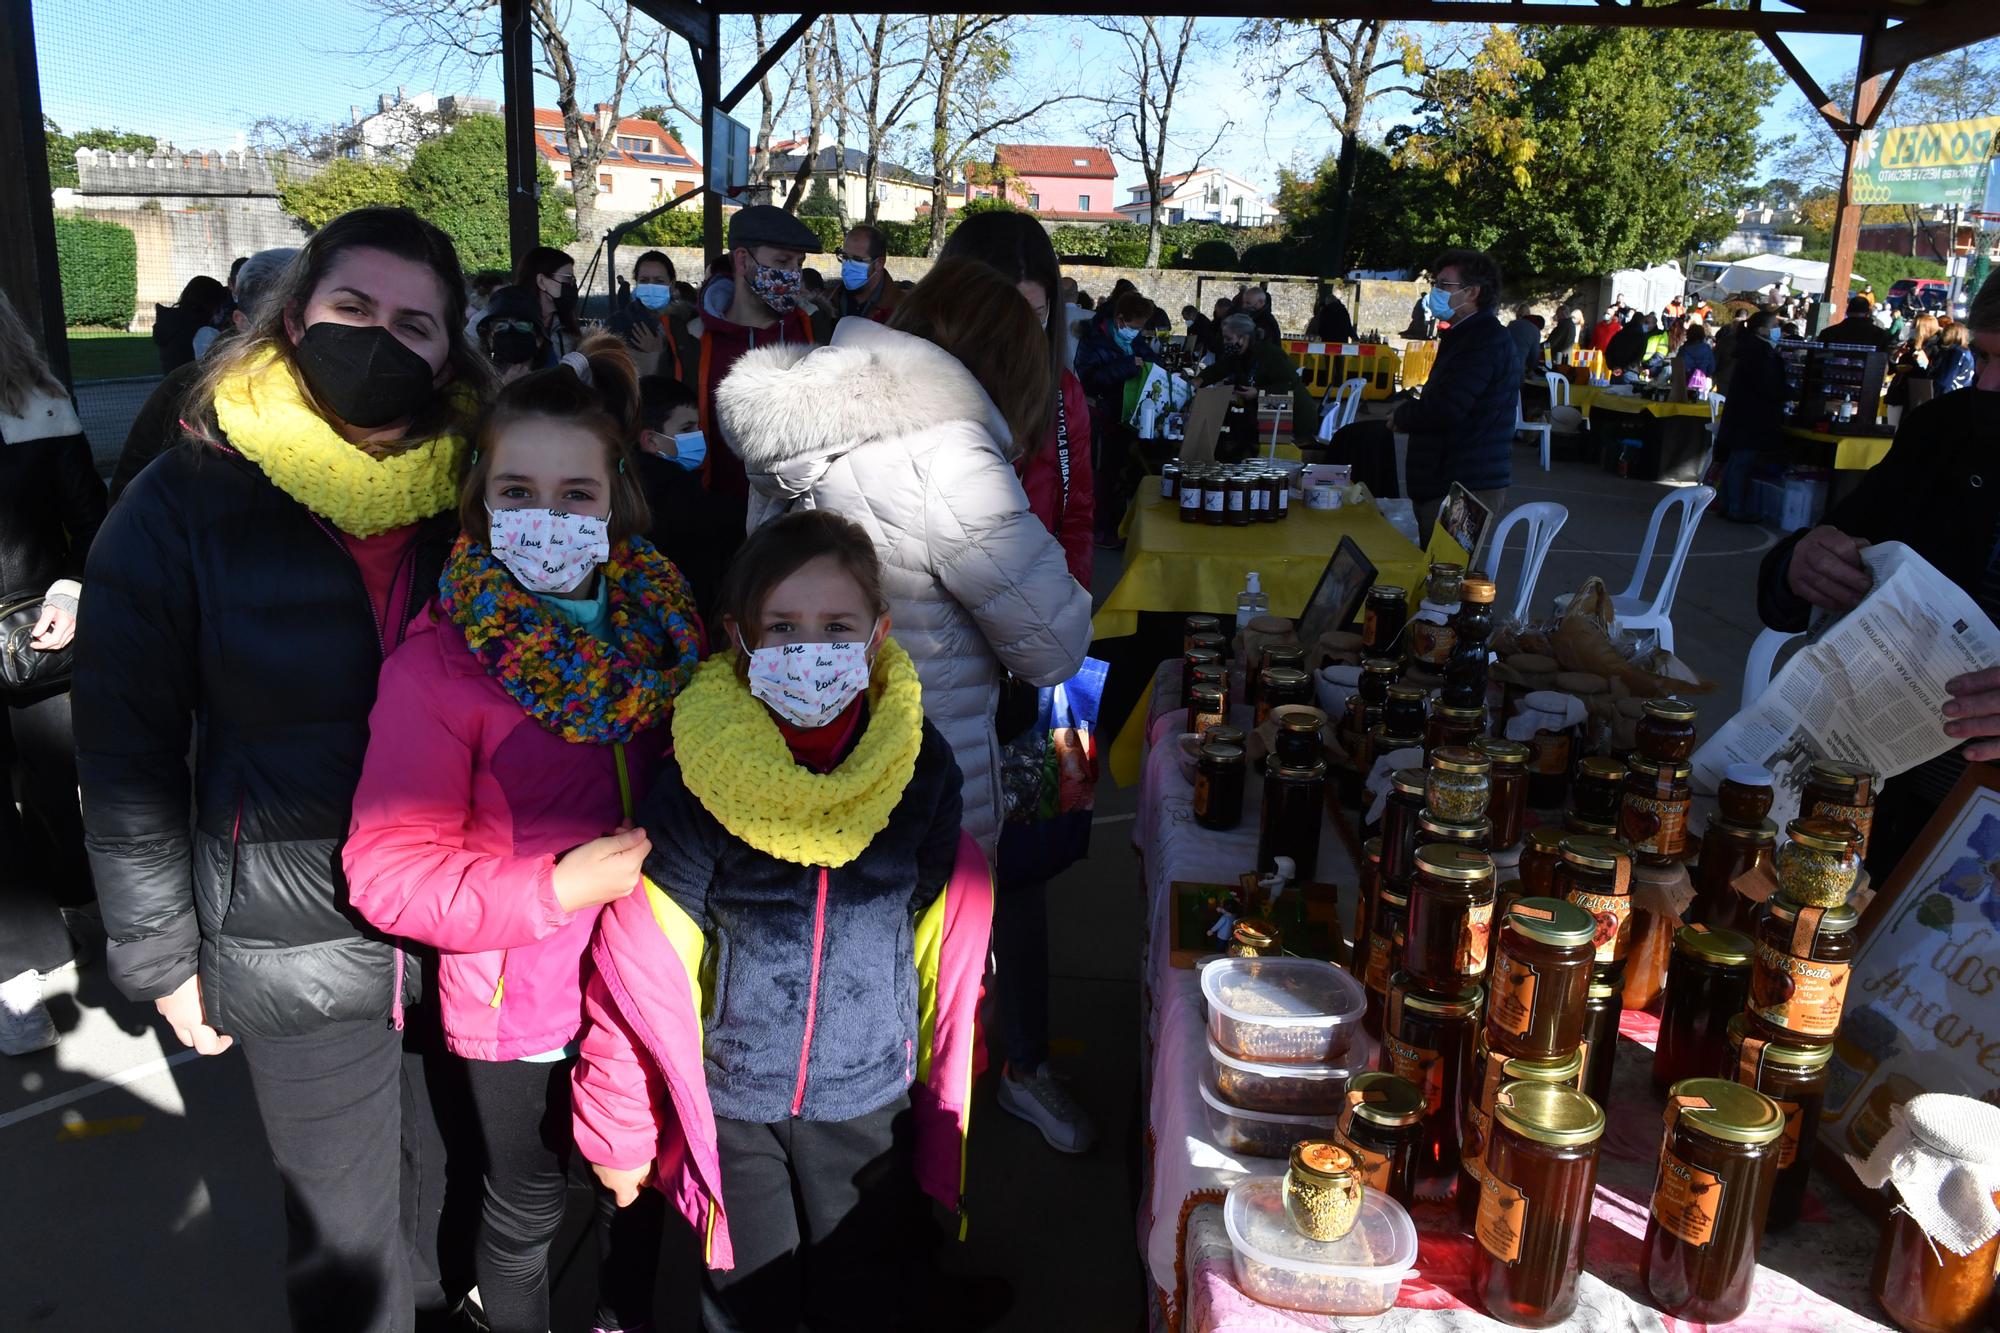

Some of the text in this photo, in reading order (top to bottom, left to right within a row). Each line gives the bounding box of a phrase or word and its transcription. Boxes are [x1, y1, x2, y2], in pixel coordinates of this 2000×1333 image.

[1058, 448, 1070, 484] BIMBA
[578, 524, 597, 536] love
[520, 532, 543, 549] love
[549, 534, 565, 546] love
[542, 560, 567, 574] love
[815, 656, 833, 667] love
[1893, 660, 1913, 682] PARA
[815, 675, 839, 692] love
[1909, 680, 1931, 707] PEDIDO
[1603, 899, 1615, 910] de
[1931, 928, 2000, 995] dos
[1796, 963, 1833, 980] Souto
